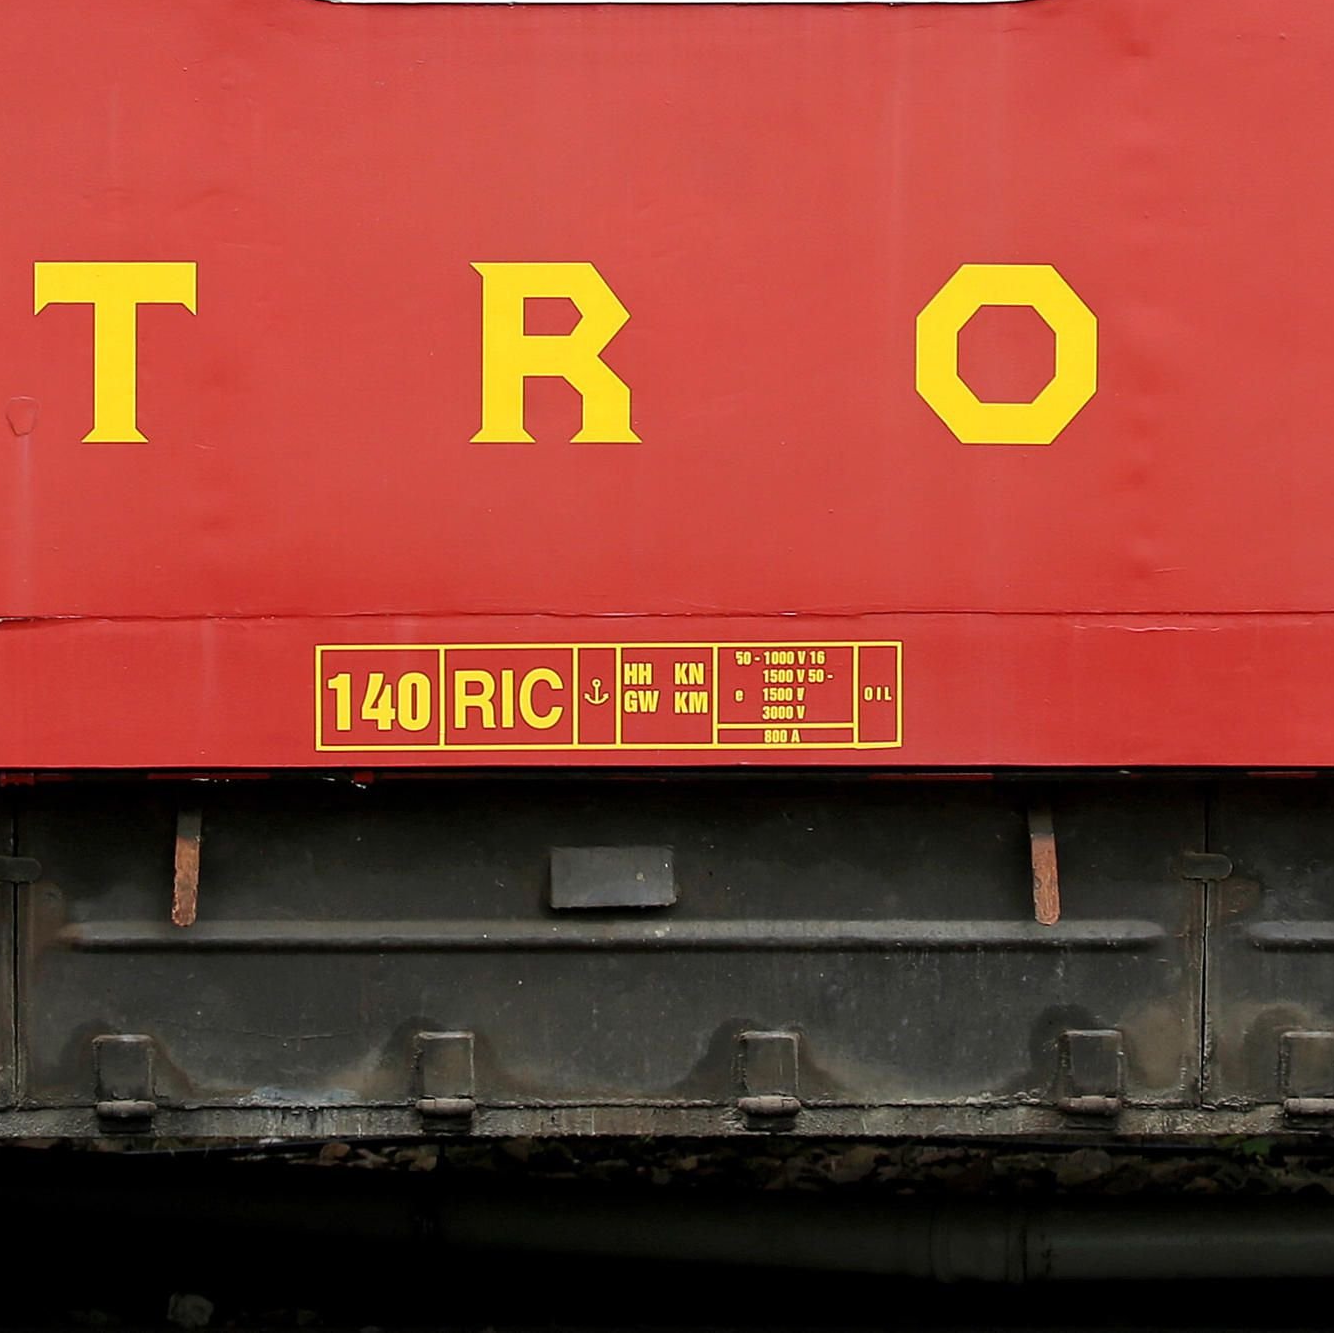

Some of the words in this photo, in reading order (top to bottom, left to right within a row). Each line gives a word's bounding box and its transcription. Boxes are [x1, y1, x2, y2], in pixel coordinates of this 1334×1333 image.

[735, 651, 752, 665] 50
[763, 650, 795, 665] 1000
[797, 650, 806, 665] V
[809, 650, 825, 665] 16
[624, 663, 652, 685] HH
[674, 662, 704, 685] KN
[762, 669, 794, 683] 1500
[796, 669, 805, 683] V
[808, 668, 824, 683] 50
[327, 672, 431, 731] 140
[454, 668, 564, 729] RIC
[624, 690, 660, 713] GW
[674, 691, 708, 714] KM
[762, 687, 793, 702] 1500
[796, 687, 805, 701] V
[762, 705, 794, 720] 3000
[796, 705, 805, 719] V
[764, 729, 788, 744] 800
[790, 729, 801, 743] A
